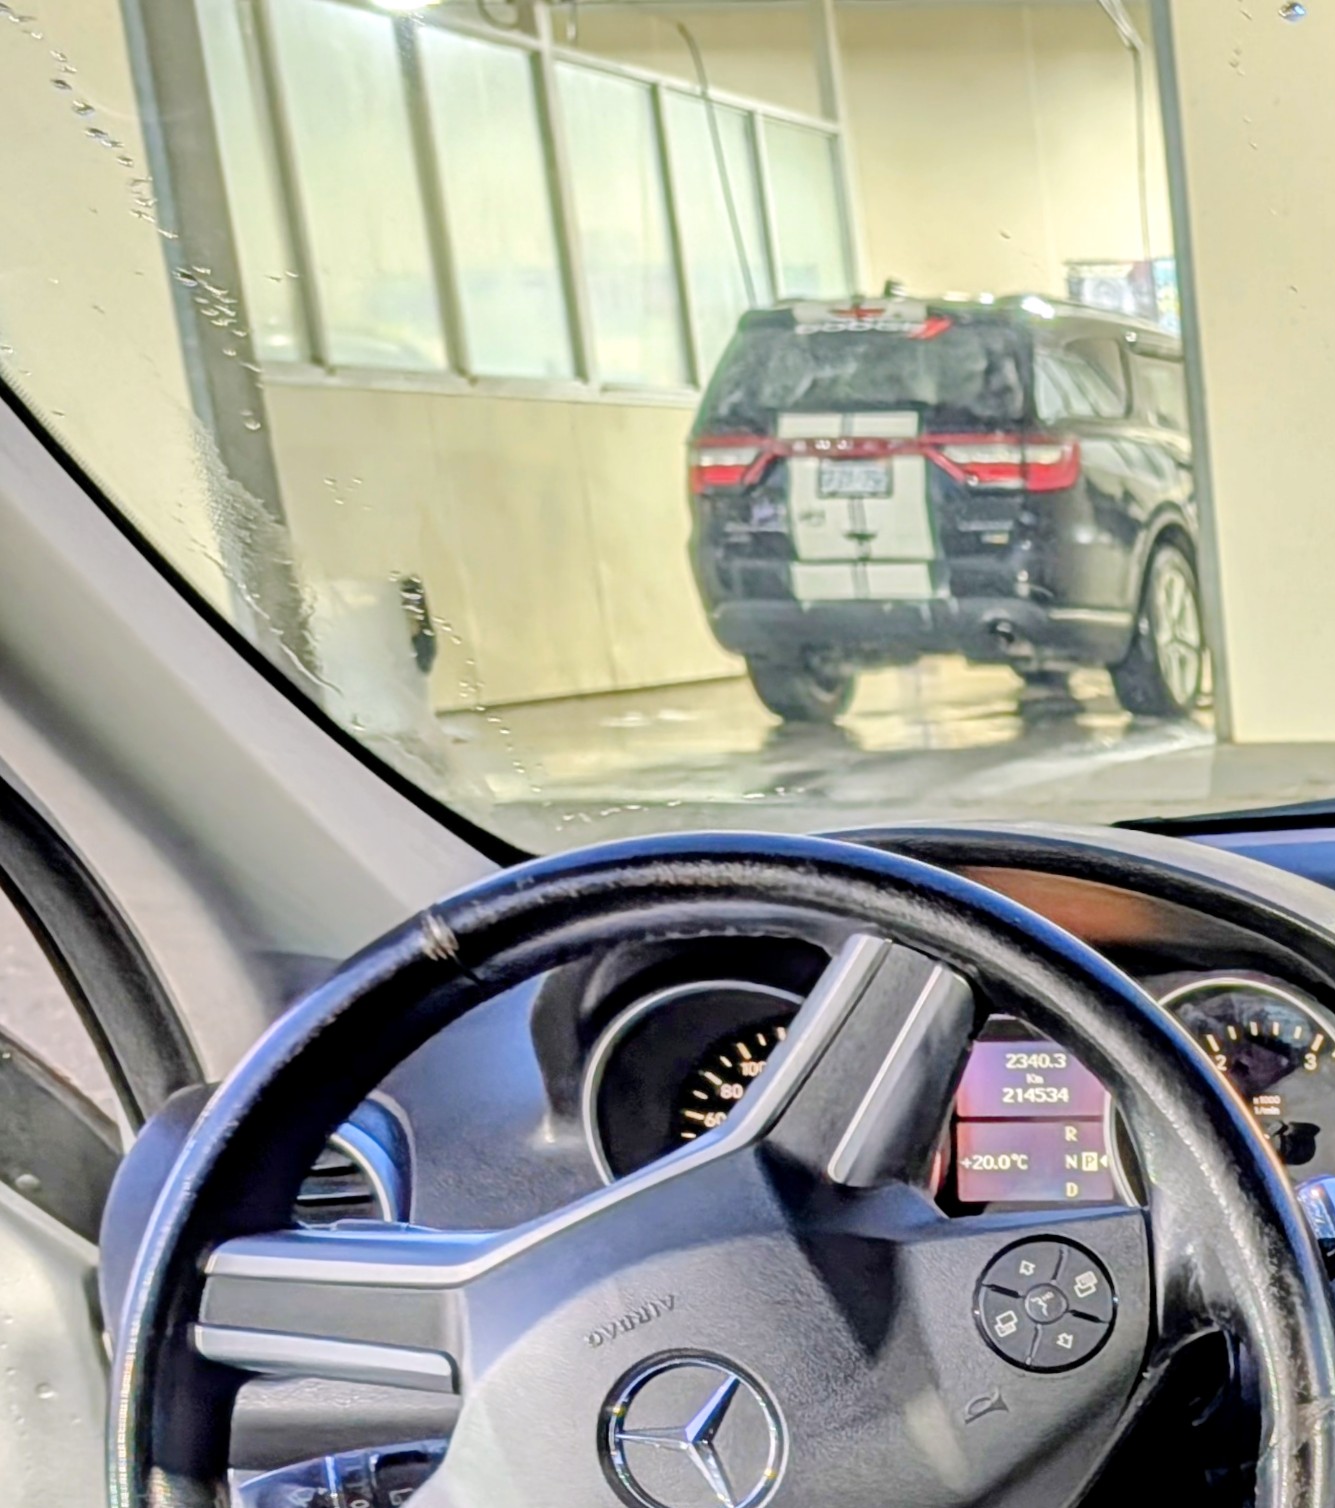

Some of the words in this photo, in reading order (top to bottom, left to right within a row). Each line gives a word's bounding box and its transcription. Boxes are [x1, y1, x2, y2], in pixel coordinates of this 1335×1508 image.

[1005, 1052, 1067, 1069] 2340.3
[1215, 1054, 1227, 1072] 2
[1304, 1053, 1317, 1070] 3
[1002, 1087, 1069, 1103] 214534
[1065, 1126, 1077, 1142] R
[1065, 1154, 1078, 1170] N
[1084, 1154, 1096, 1169] P
[1066, 1183, 1078, 1198] D
